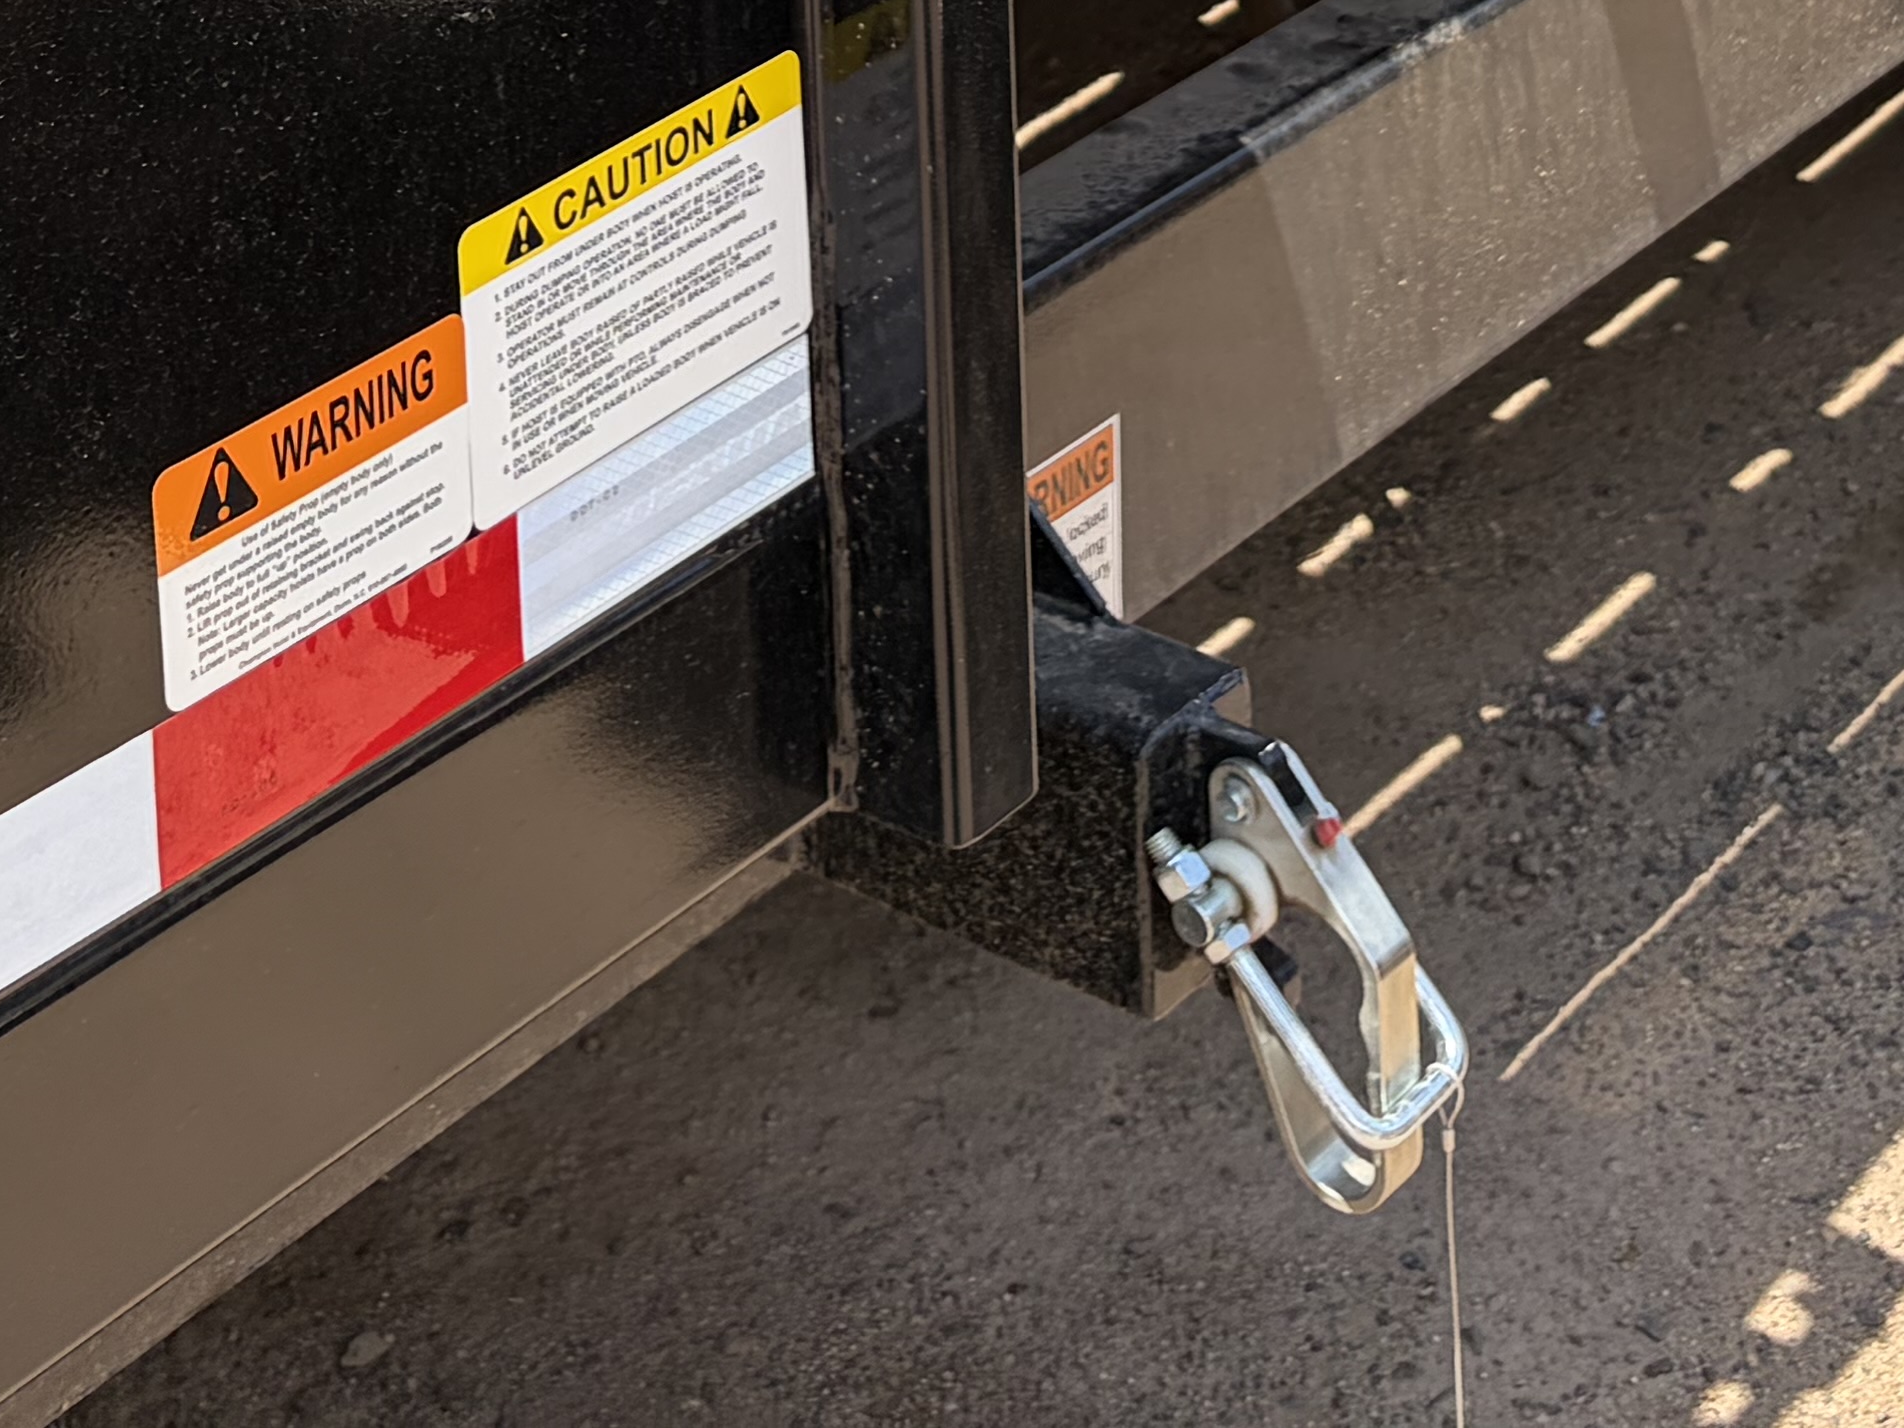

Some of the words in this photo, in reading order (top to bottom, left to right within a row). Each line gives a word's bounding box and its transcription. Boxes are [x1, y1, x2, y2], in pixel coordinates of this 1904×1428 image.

[554, 110, 714, 229] CAUTION
[272, 351, 433, 479] WARNING
[1033, 440, 1110, 513] RNING
